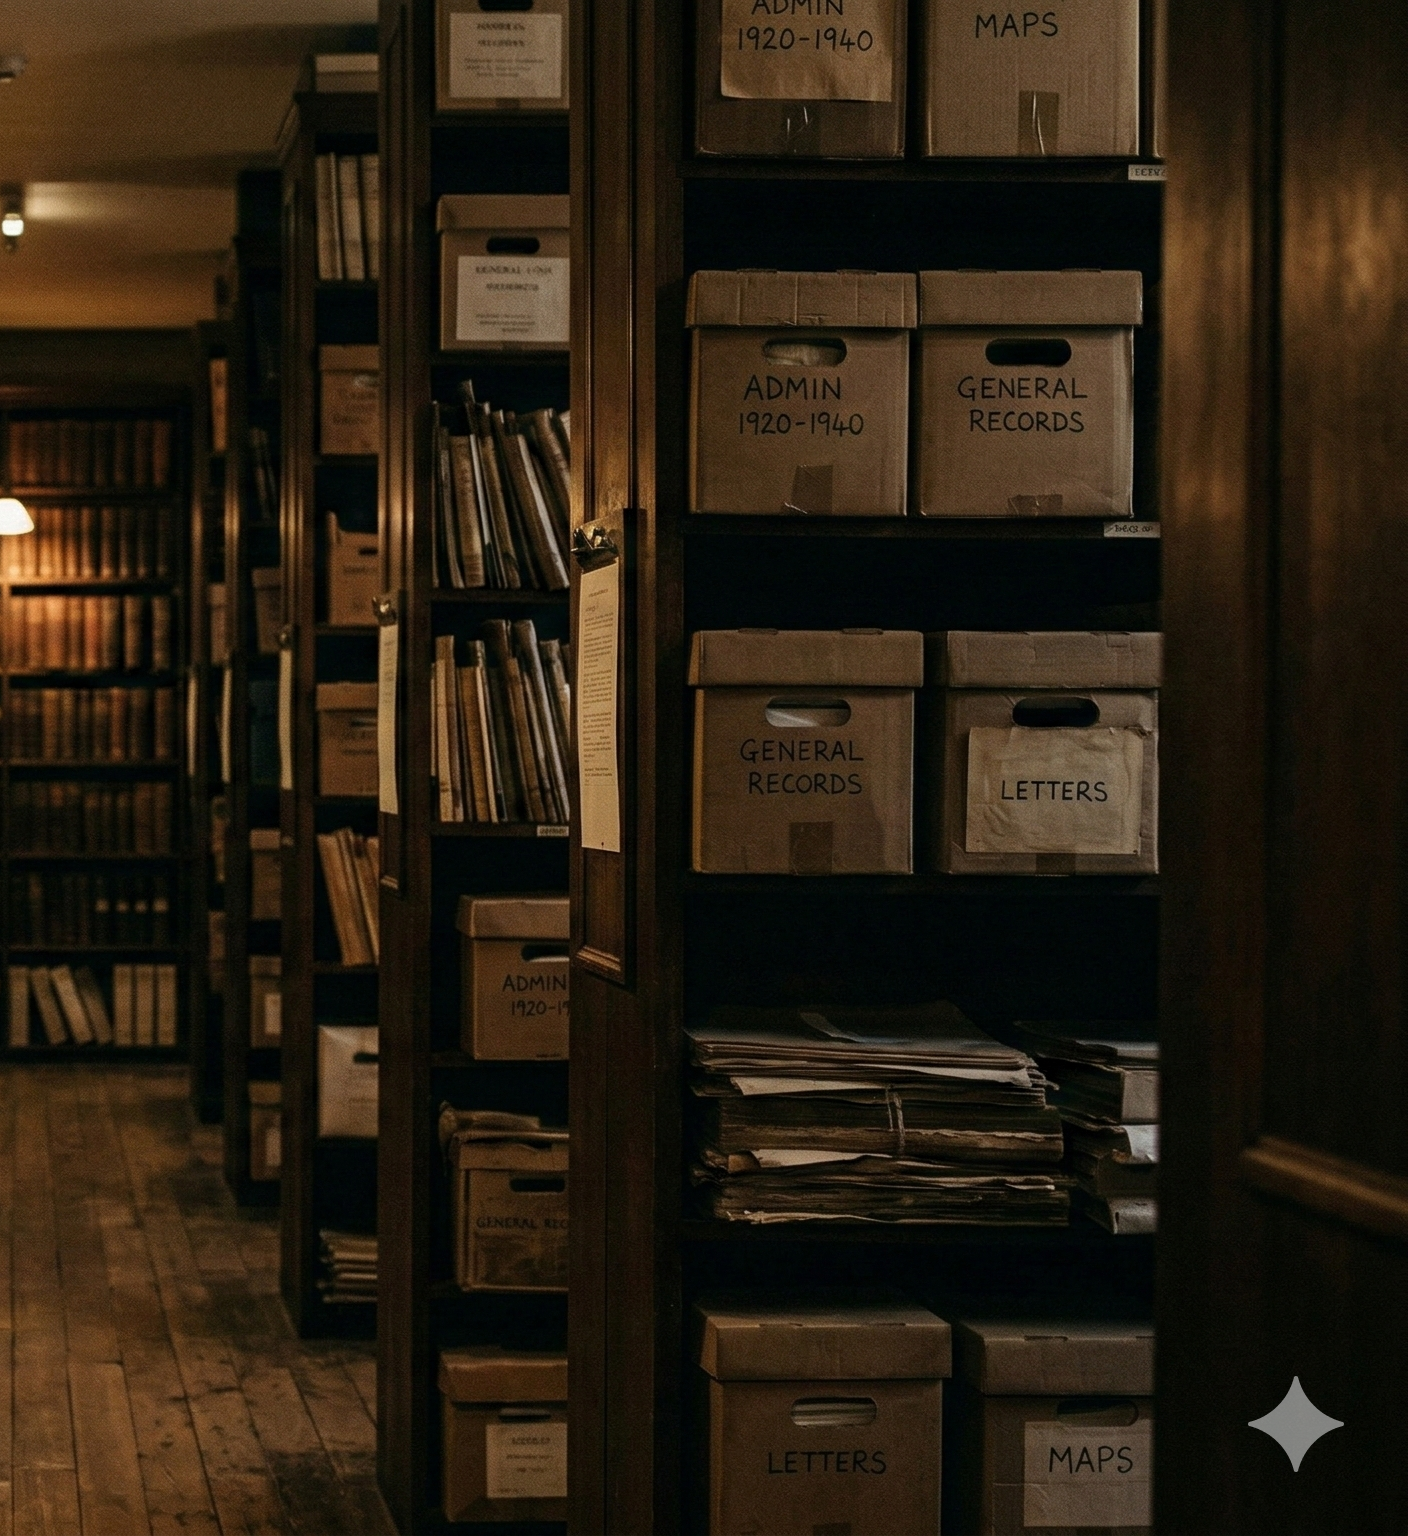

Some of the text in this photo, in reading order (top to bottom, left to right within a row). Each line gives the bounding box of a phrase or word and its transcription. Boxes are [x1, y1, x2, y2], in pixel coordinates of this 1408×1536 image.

[751, 0, 844, 16] ADMIN
[975, 11, 1058, 39] MAPS
[738, 25, 873, 52] 1920-1940
[743, 374, 841, 401] ADMIN
[956, 375, 1088, 402] GENERAL
[739, 411, 864, 437] 1920-1940
[969, 408, 1084, 433] RECORDS
[739, 738, 864, 764] GENERAL
[748, 770, 862, 795] RECORDS
[1001, 780, 1108, 802] LETTERS
[502, 974, 567, 992] ADMIN
[476, 1216, 538, 1230] GENERAL
[768, 1449, 887, 1475] LETTERS
[1048, 1445, 1134, 1474] MAPS
